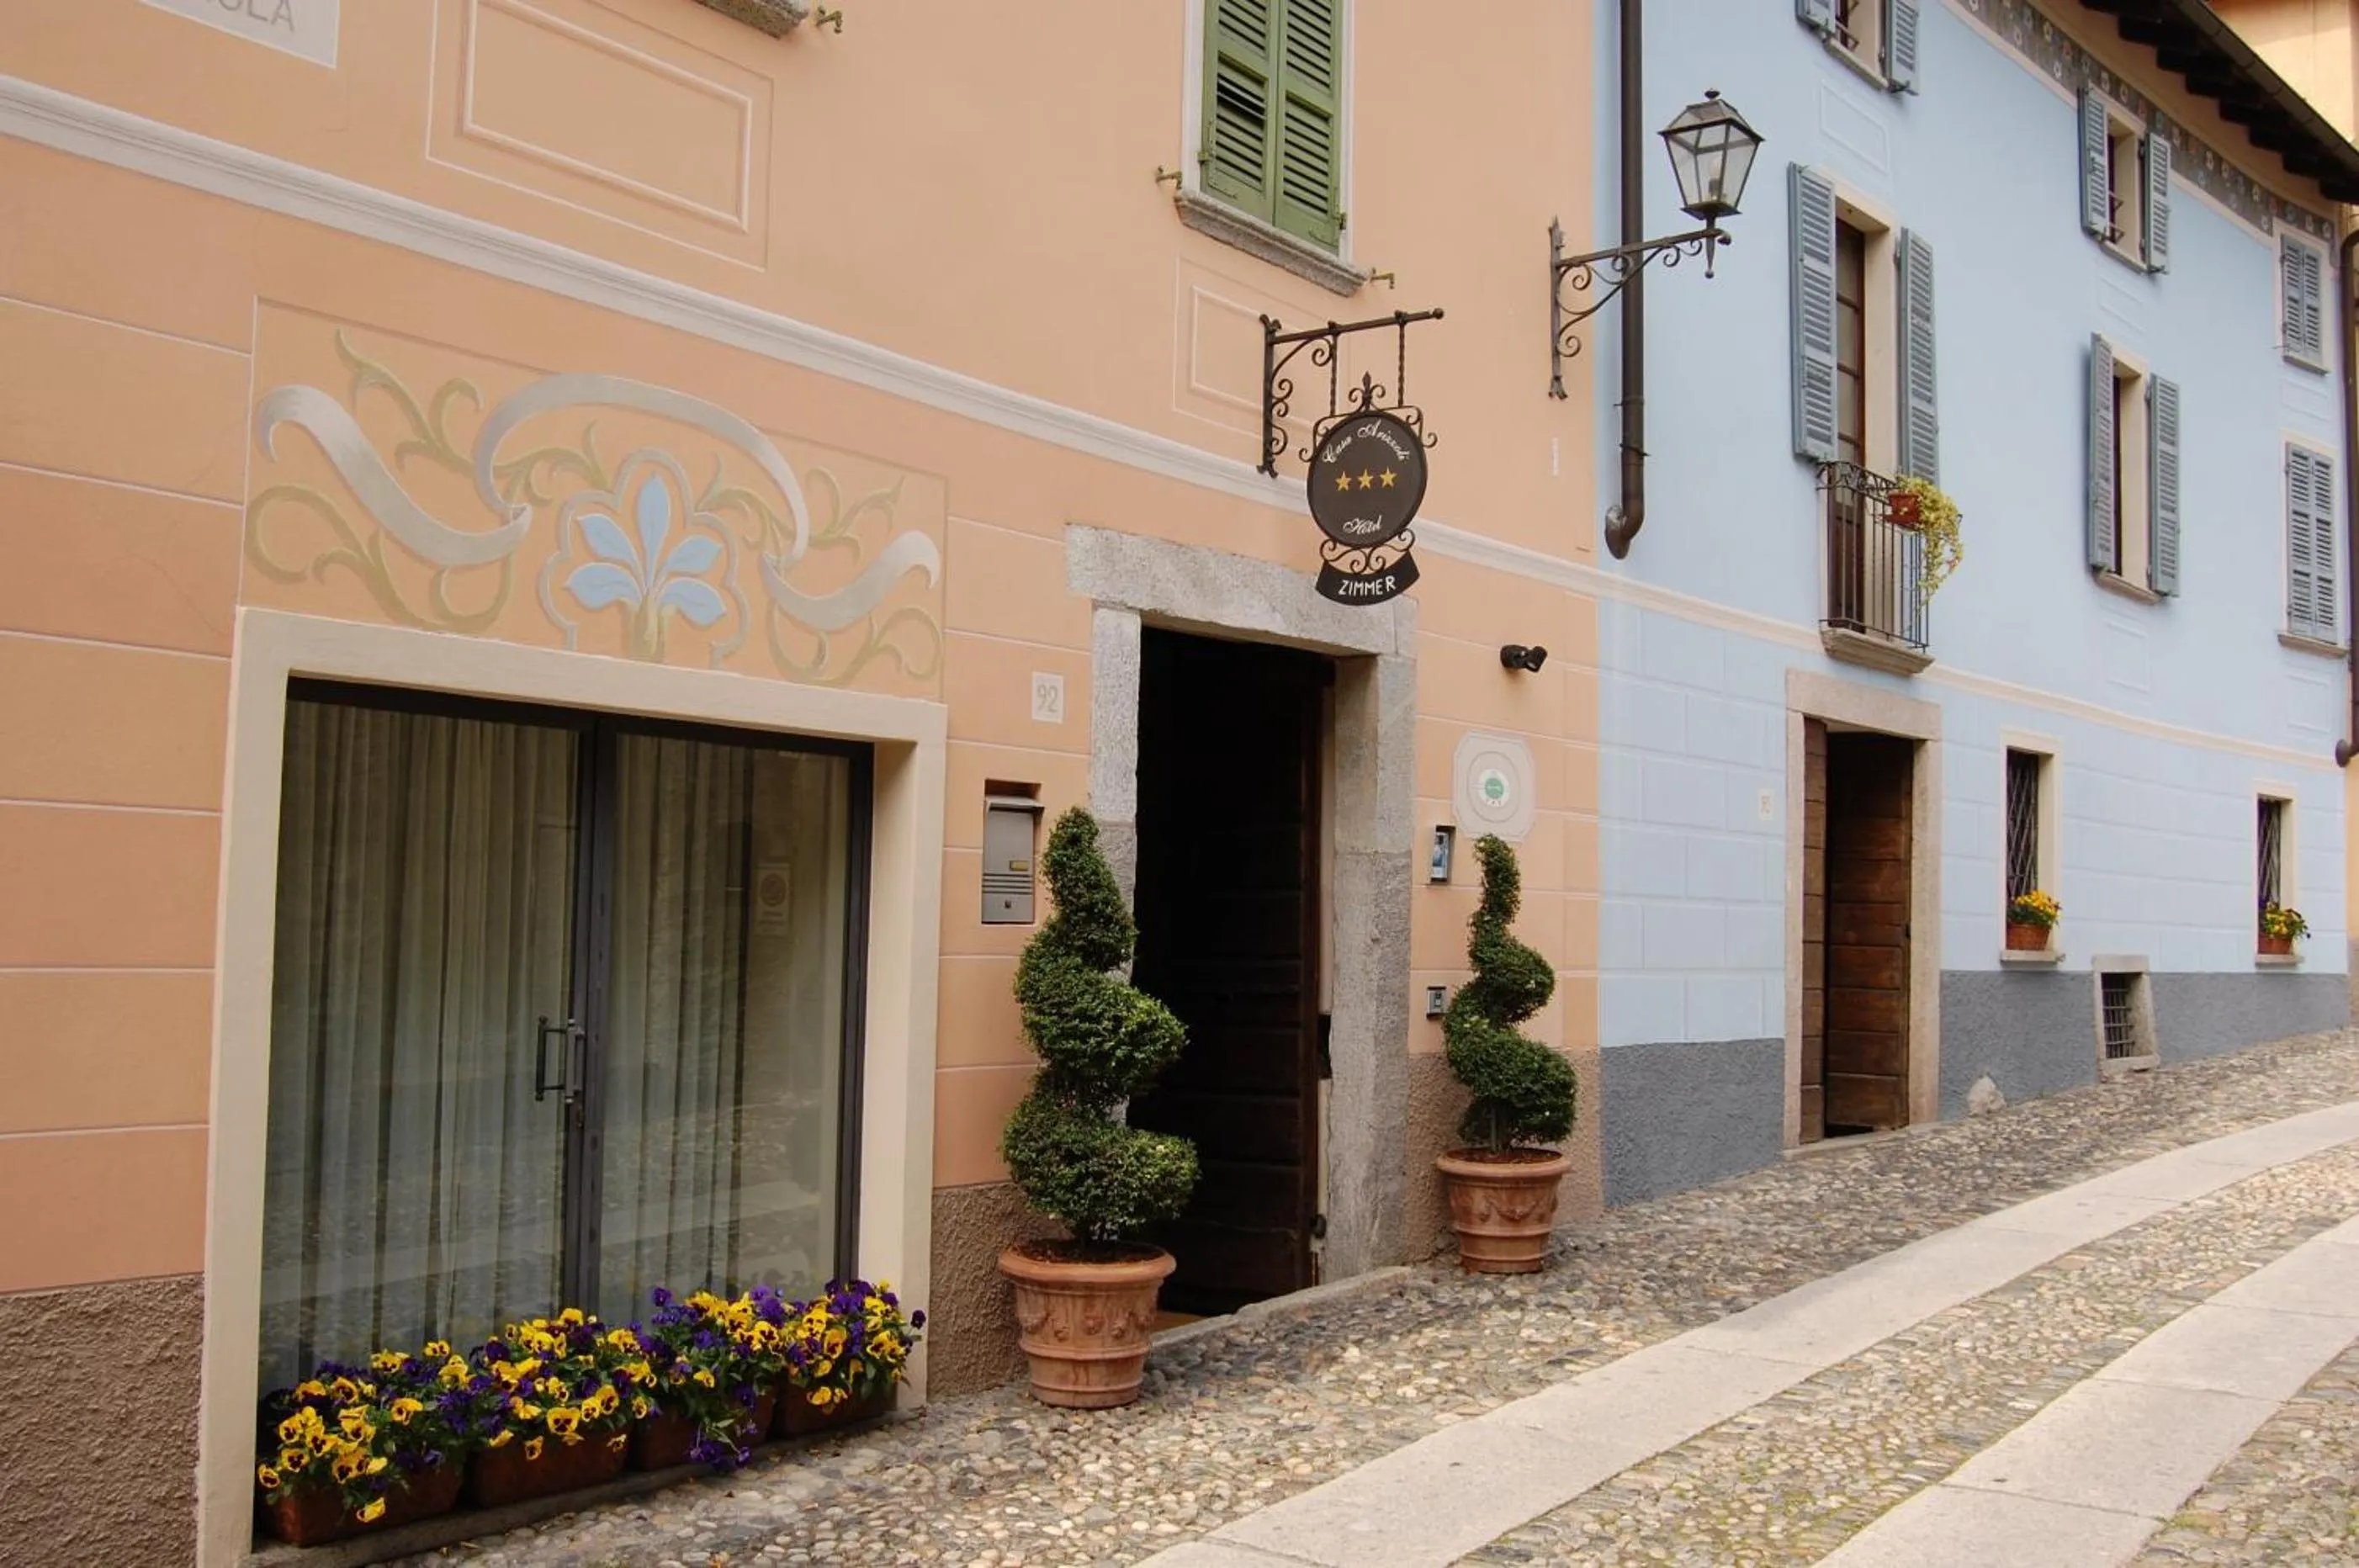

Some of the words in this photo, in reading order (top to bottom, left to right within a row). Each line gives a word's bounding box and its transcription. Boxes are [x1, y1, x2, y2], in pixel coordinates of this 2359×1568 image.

[1343, 515, 1382, 535] Hotel
[1339, 575, 1397, 596] ZIMMER
[1036, 684, 1058, 713] 92
